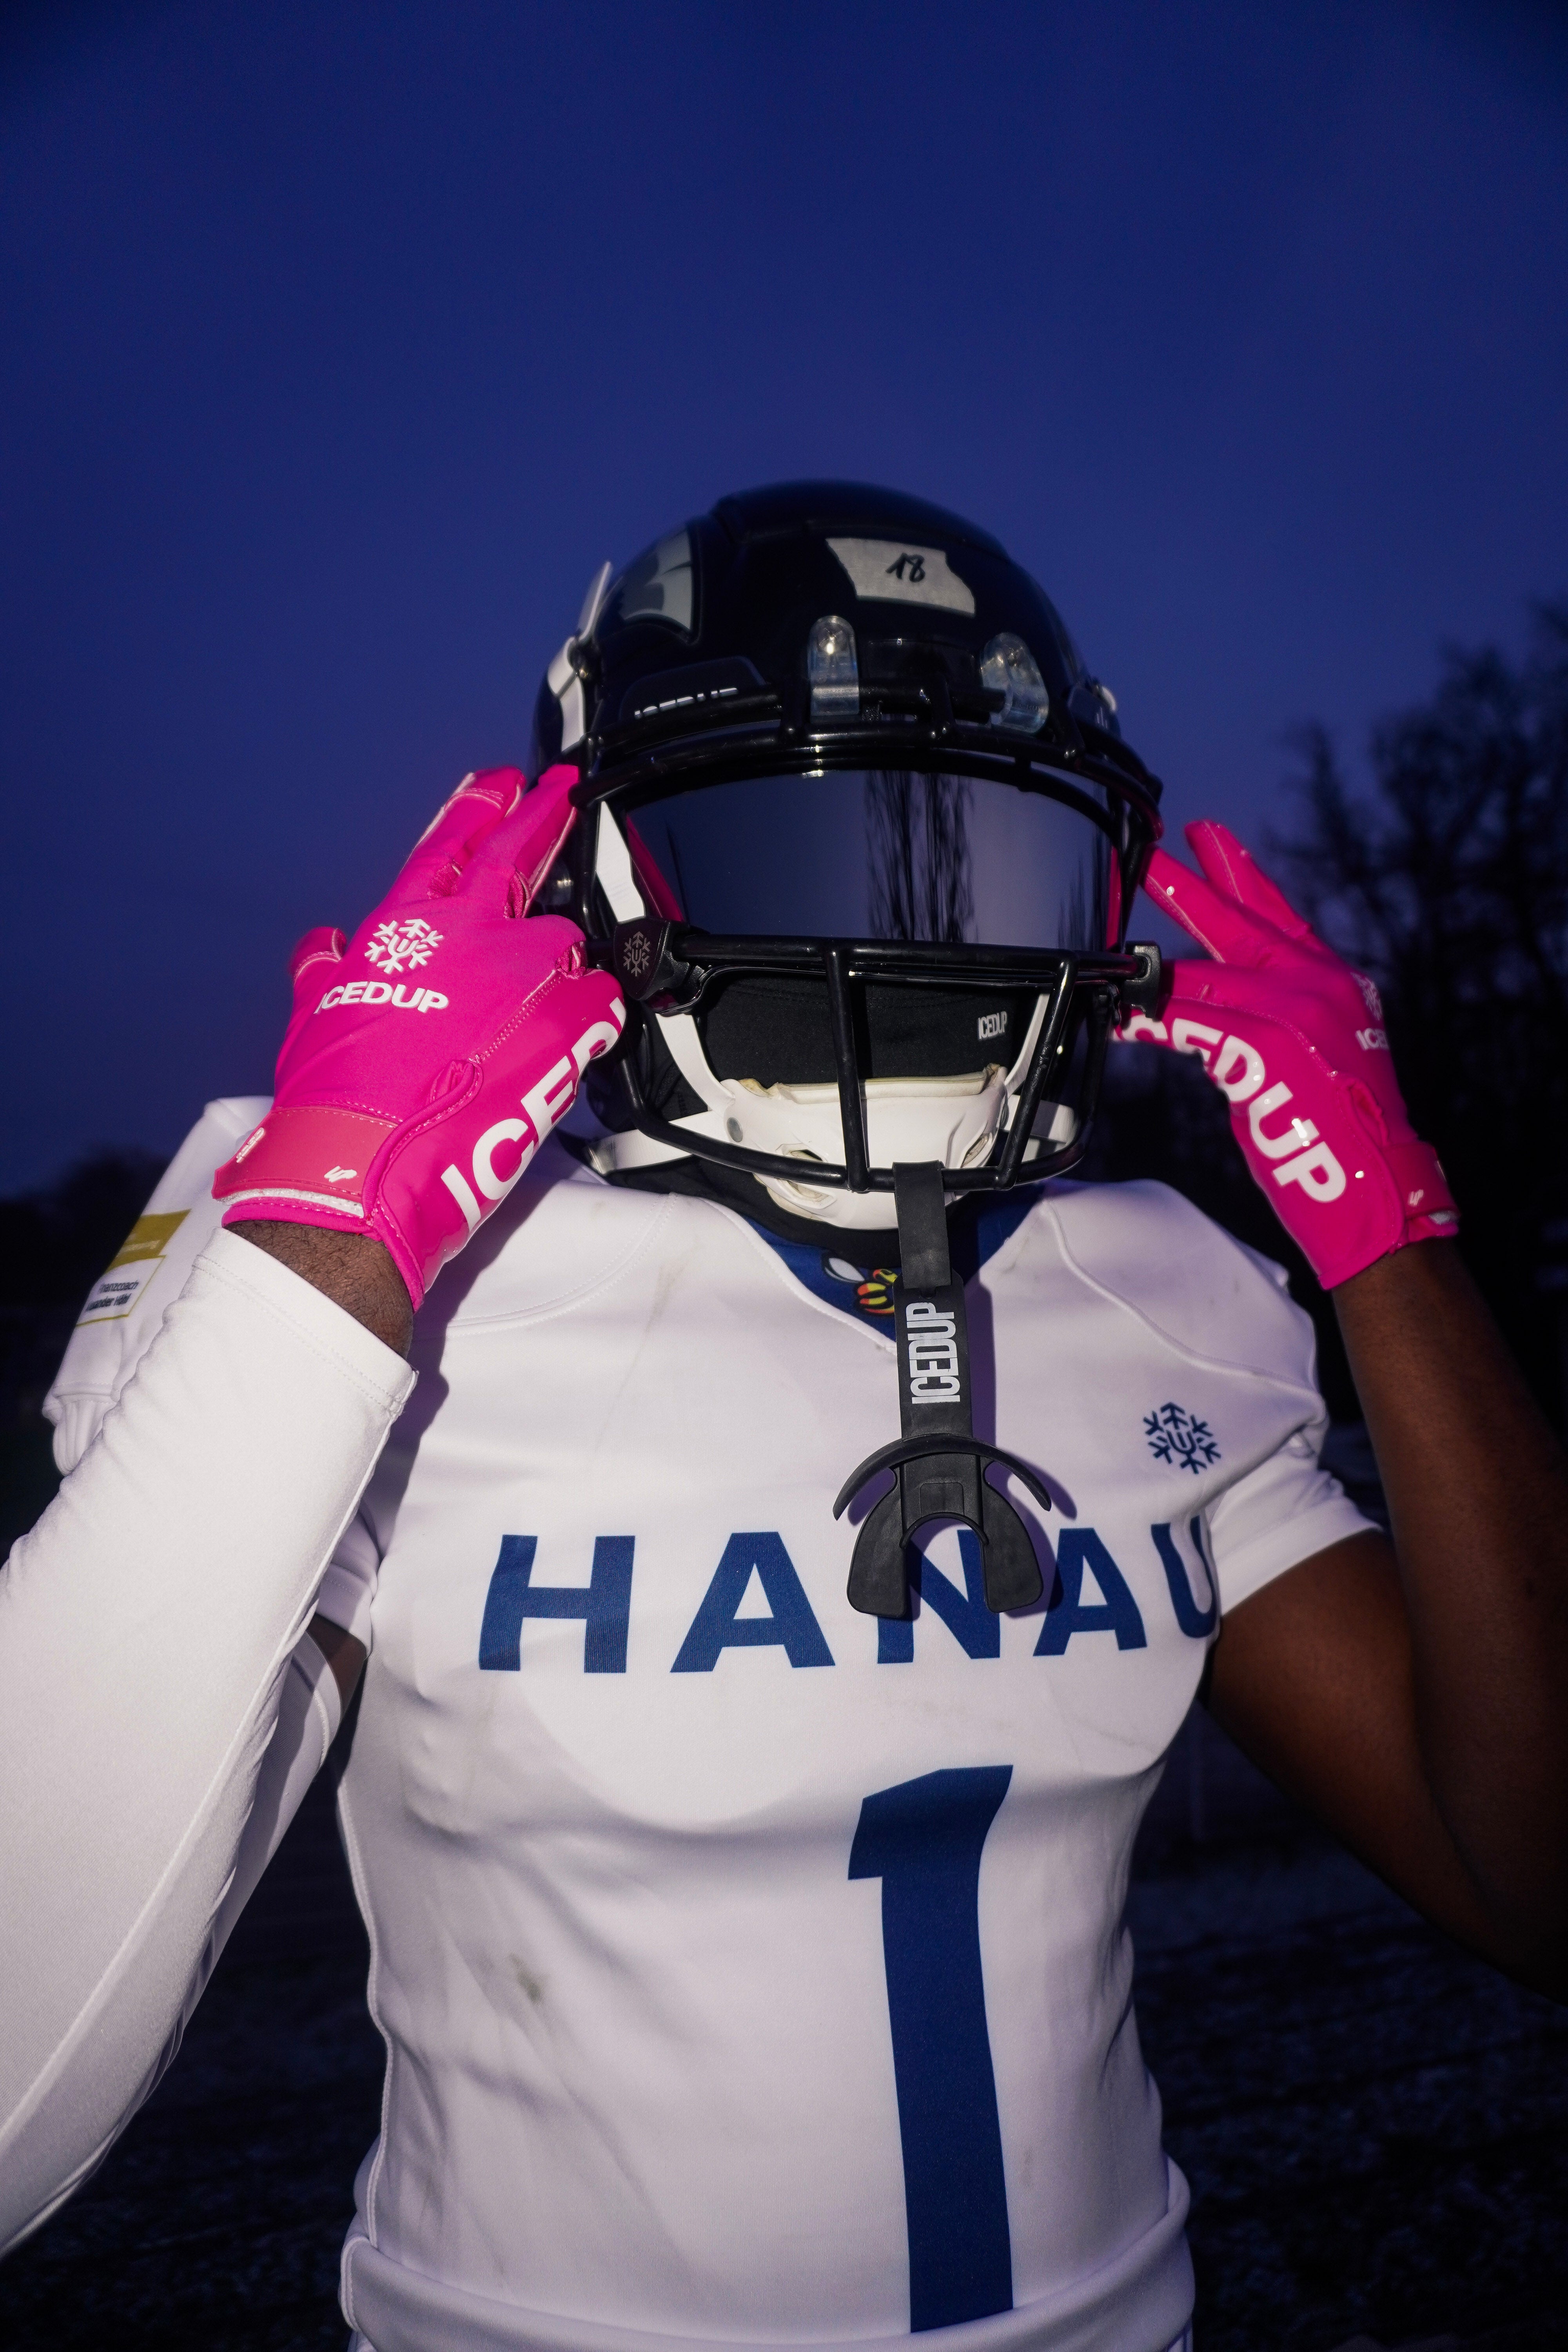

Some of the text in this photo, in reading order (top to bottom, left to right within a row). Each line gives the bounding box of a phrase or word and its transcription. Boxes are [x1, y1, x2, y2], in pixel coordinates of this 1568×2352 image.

[886, 553, 926, 583] 18
[313, 981, 449, 1013] ICEDUP
[978, 1011, 1007, 1040] ICEDUP
[1112, 1014, 1346, 1203] CEDUP
[906, 1302, 960, 1404] ICEDUP
[479, 1515, 1217, 1674] HANAU
[848, 1764, 1014, 2334] 1
